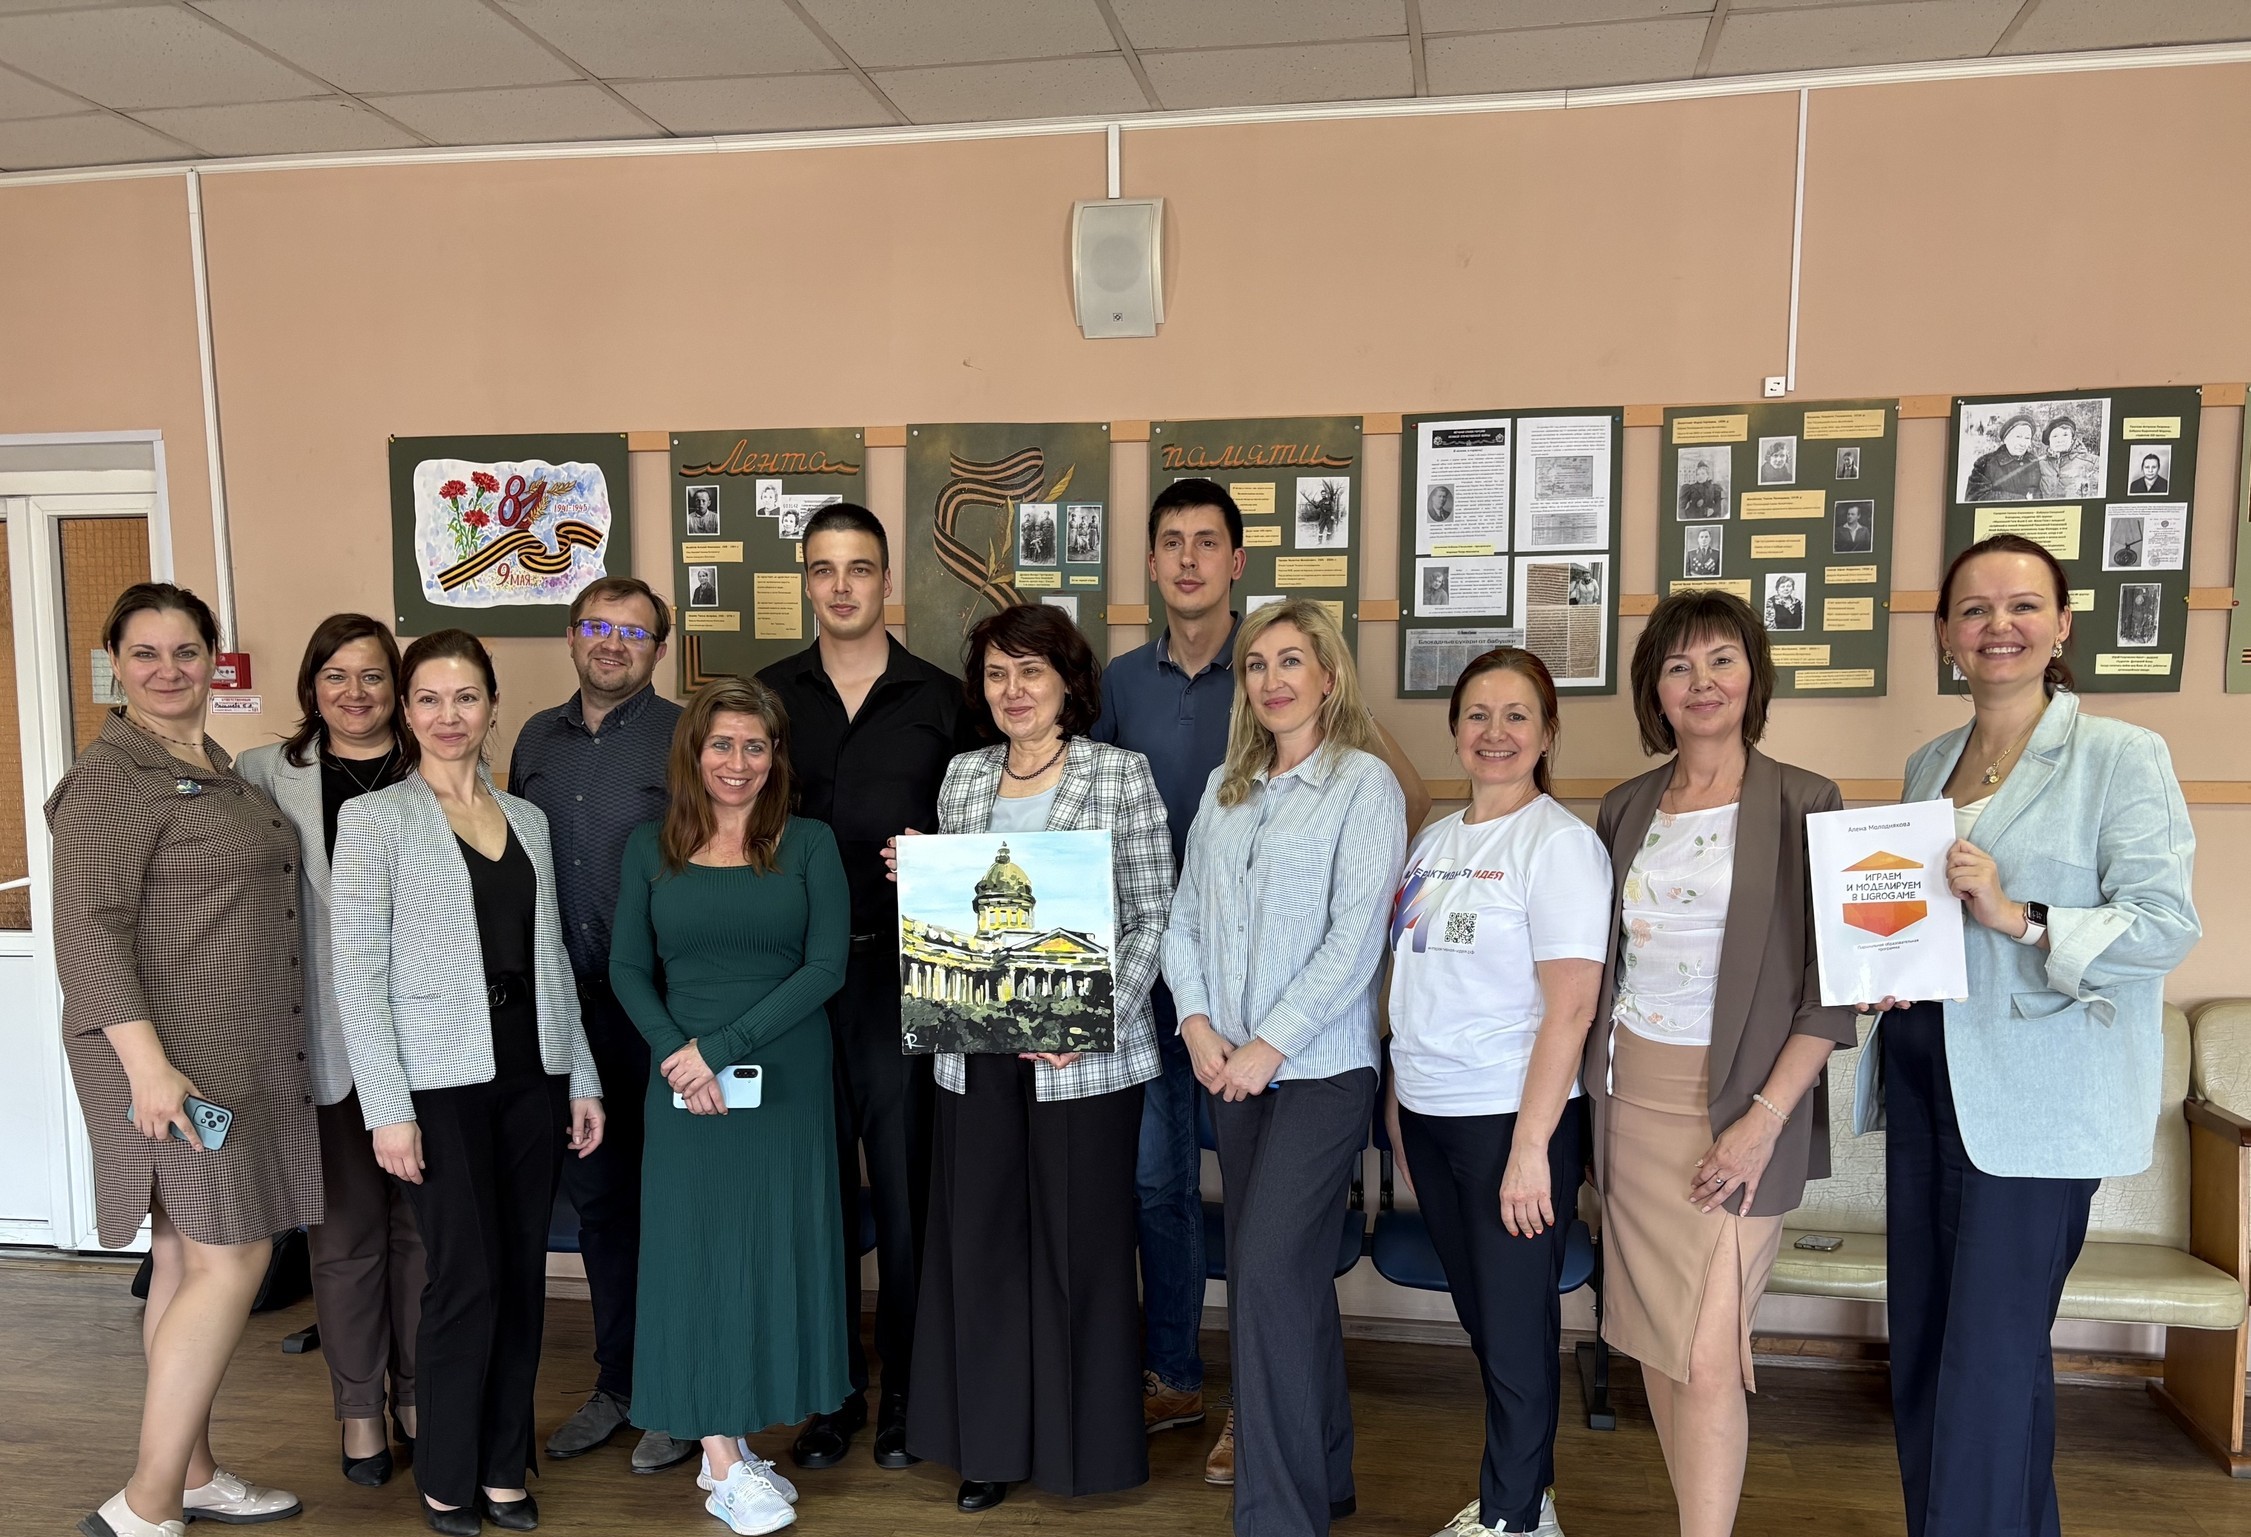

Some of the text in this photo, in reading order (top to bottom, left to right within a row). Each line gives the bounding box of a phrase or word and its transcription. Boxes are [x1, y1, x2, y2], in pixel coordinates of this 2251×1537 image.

[700, 438, 834, 475] Лента
[1161, 444, 1338, 470] памяти
[554, 503, 588, 512] 1941-1945
[496, 562, 531, 586] 9 МАЯ
[1473, 869, 1505, 881] ИДЕЯ
[1865, 872, 1902, 881] ИГРАЕМ
[1846, 881, 1921, 892] И МОДЕЛИРУЕМ
[1852, 891, 1916, 901] В LIGROGAME
